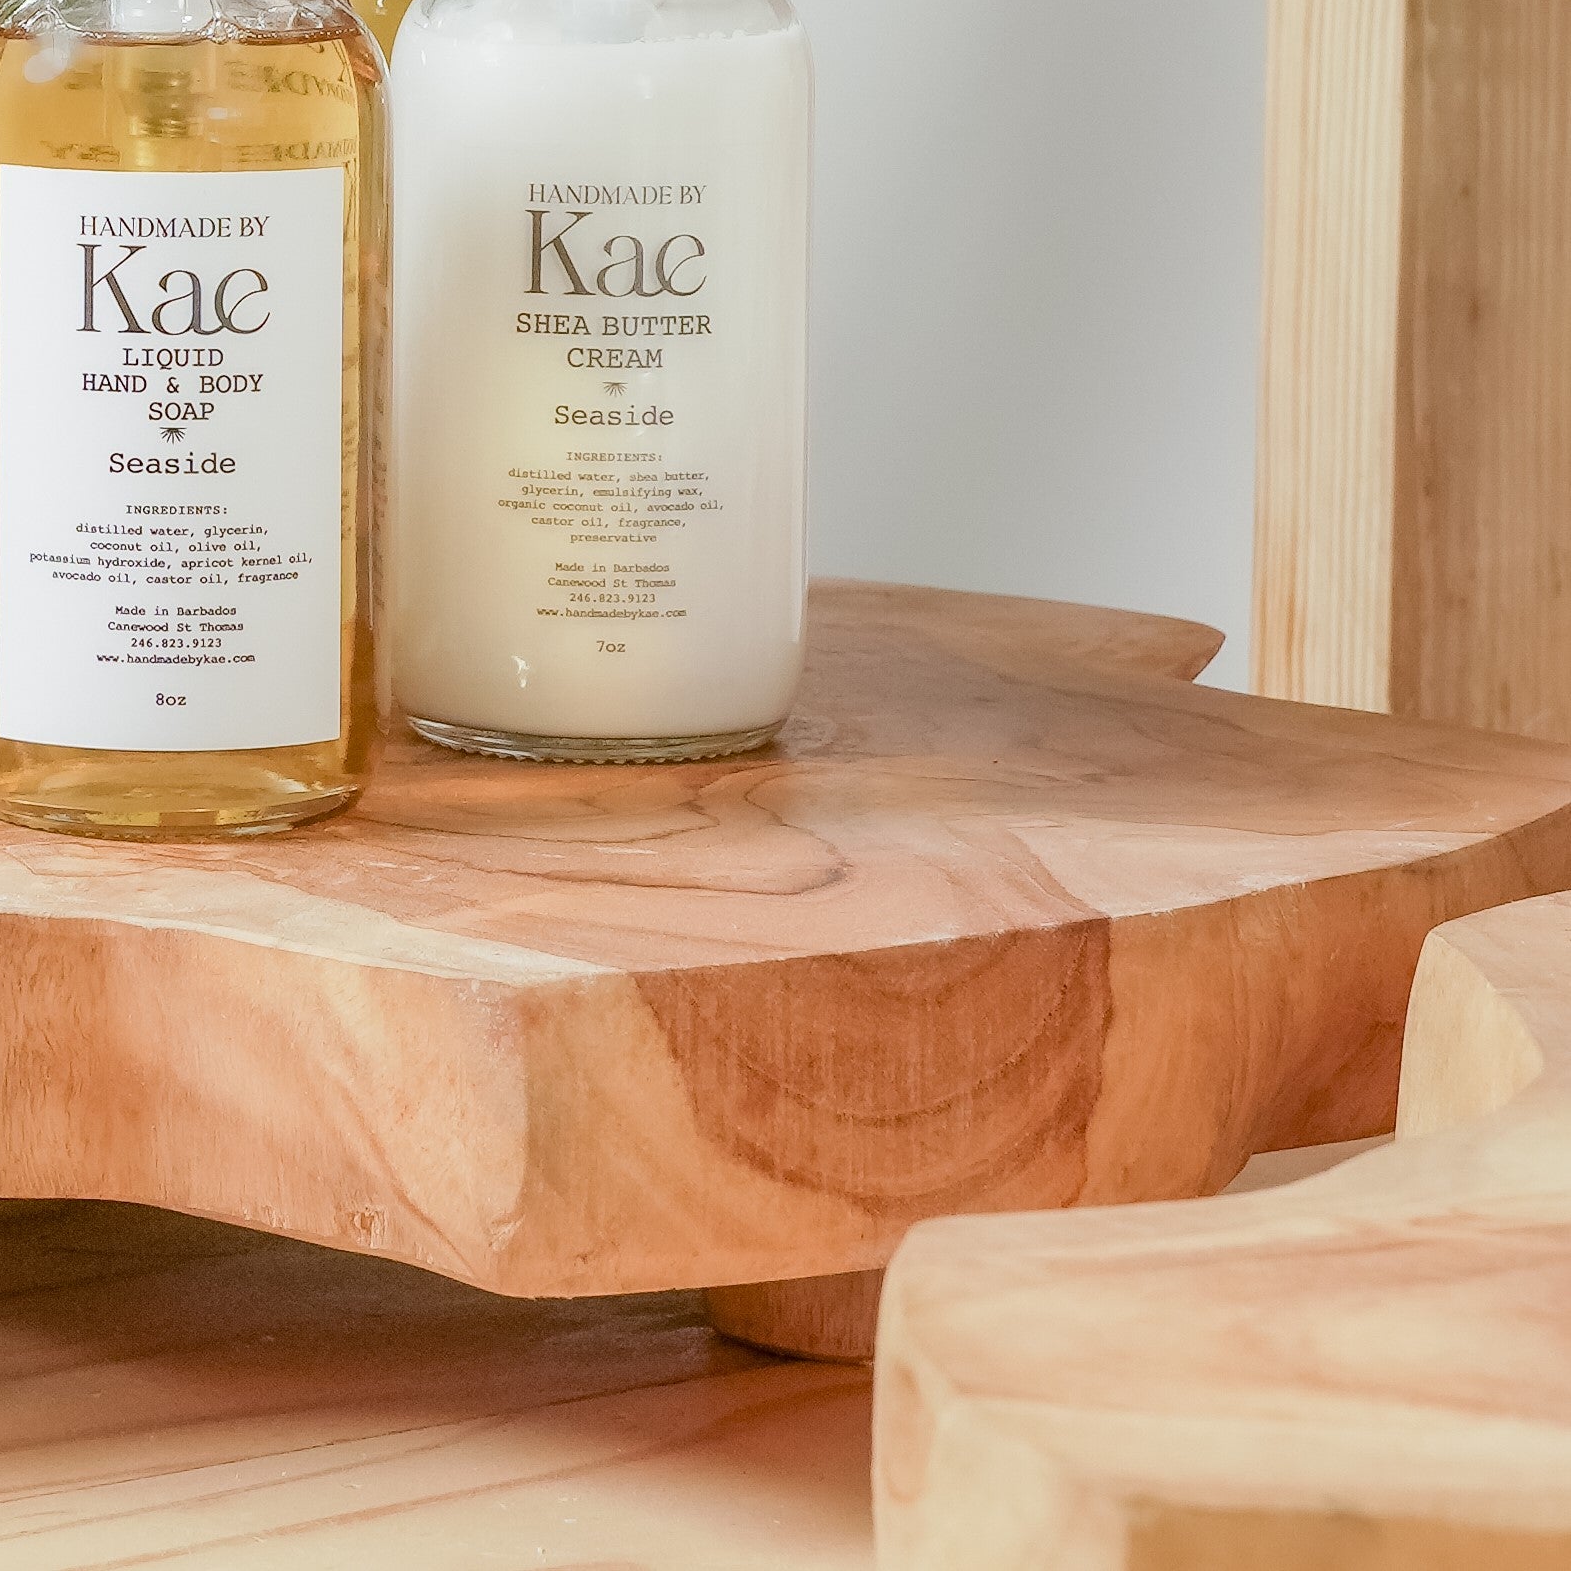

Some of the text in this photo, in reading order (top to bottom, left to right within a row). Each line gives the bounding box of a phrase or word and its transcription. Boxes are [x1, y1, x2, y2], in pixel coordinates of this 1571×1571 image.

[529, 183, 707, 206] HANDMADE BY
[80, 215, 270, 238] HANDMADE BY
[523, 209, 708, 298] Kae
[75, 243, 271, 336] Kae
[516, 312, 713, 337] SHEA BUTTER
[122, 347, 224, 371] LIQUID
[566, 347, 664, 369] CREAM
[82, 372, 264, 394] HAND & BODY
[148, 401, 215, 421] SOAP
[554, 404, 674, 426] Seaside
[109, 451, 236, 475] Seaside
[565, 451, 663, 463] INGREDIENTS:
[507, 468, 709, 484] distilled water, shea butter,
[521, 482, 703, 500] glycerin, emulsifying wax,
[125, 504, 228, 516] INGREDIENTS:
[497, 498, 724, 514] organic coconut oil, avocado oil,
[75, 522, 268, 539] distilled water, glycerin,
[530, 516, 686, 530] castor oil, fragrance,
[569, 531, 658, 545] preservative
[89, 539, 261, 555] coconut oil, olive oil,
[29, 552, 313, 571] potassium hydroxide, apricot kernel oil,
[52, 570, 299, 586] avocado oil, castor oil, fragrance
[568, 592, 656, 605] 246.823.9123
[115, 605, 237, 617] Made in Barbados
[107, 621, 244, 633] Canewood St Thomas
[130, 637, 222, 649] 246.823.9123
[595, 640, 626, 653] 7oz
[96, 652, 256, 667] www.handmadebykae.com
[155, 692, 187, 707] 8oz
